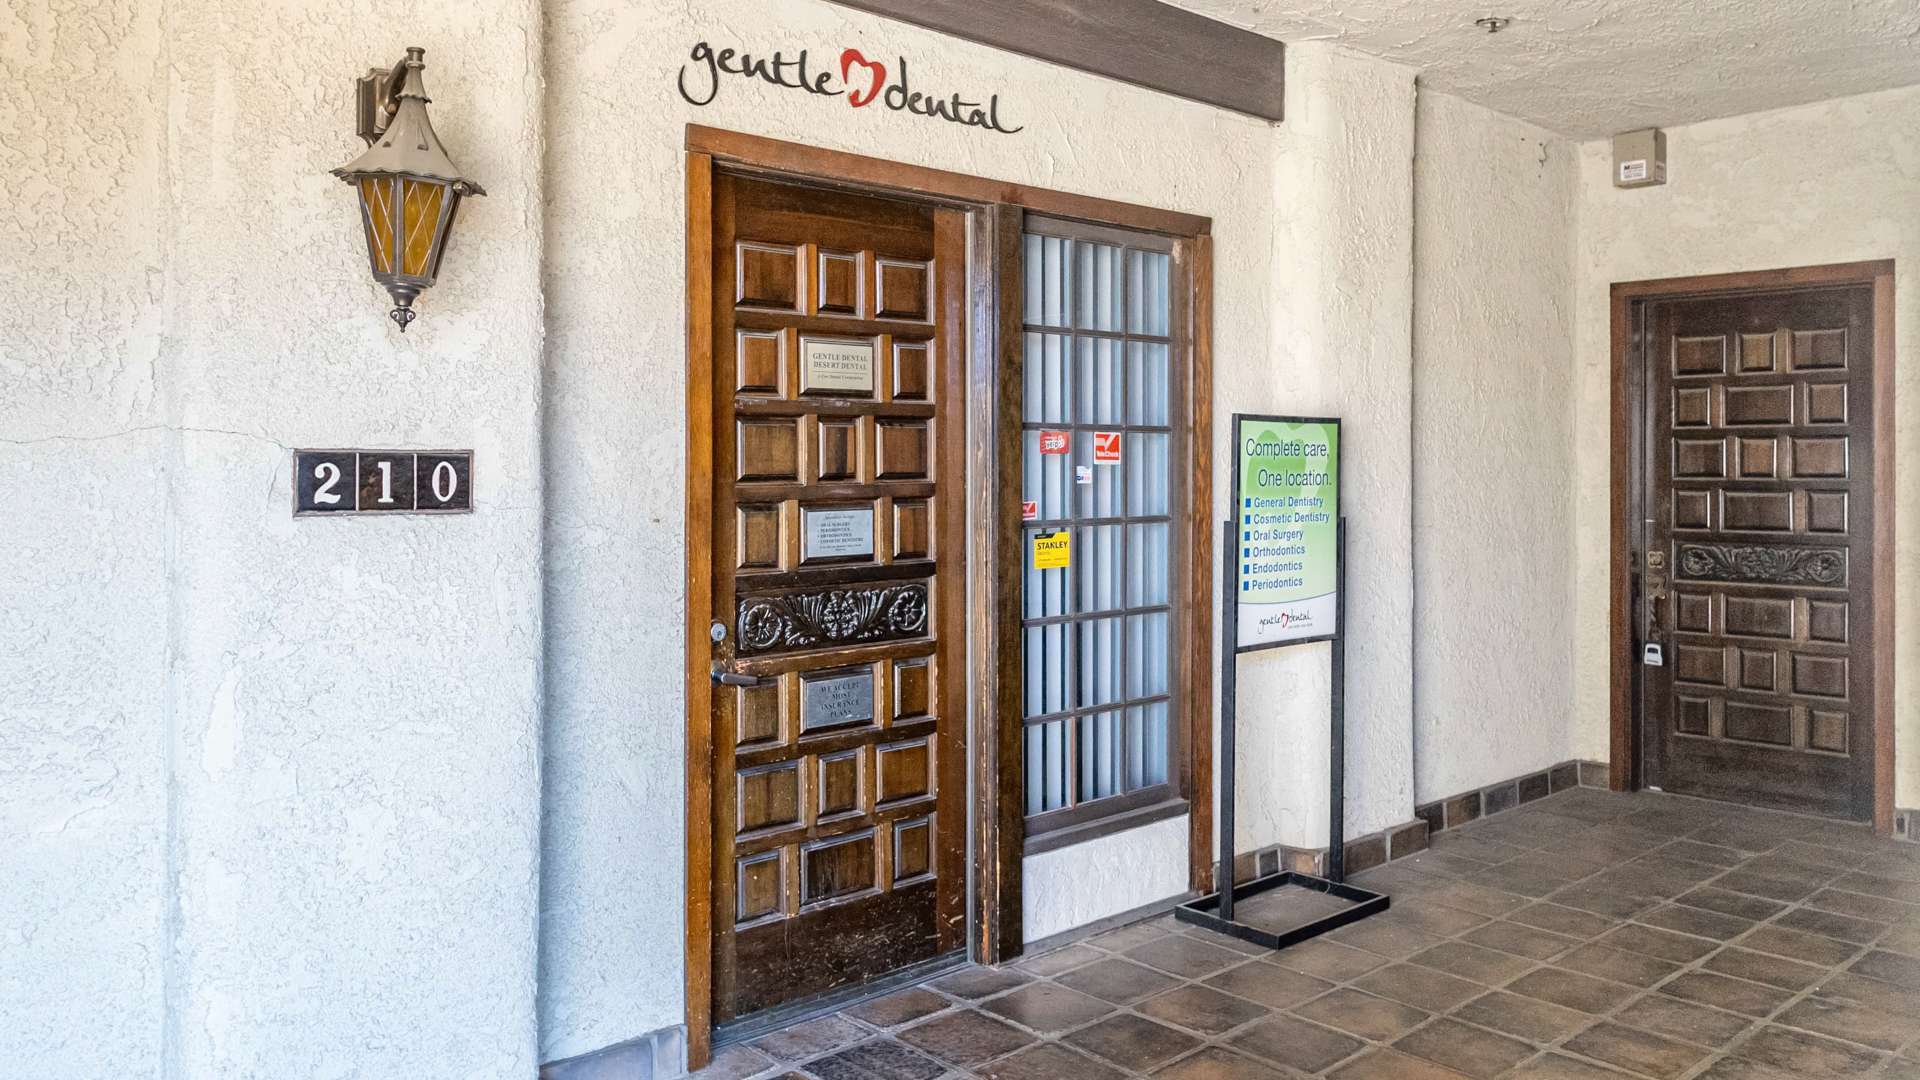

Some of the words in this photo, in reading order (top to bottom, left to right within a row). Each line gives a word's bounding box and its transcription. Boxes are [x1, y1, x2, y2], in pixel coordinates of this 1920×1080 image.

[678, 41, 844, 105] gentle
[884, 56, 1023, 134] dental
[813, 353, 840, 361] GENTLE
[842, 354, 868, 362] DENTAL
[814, 361, 840, 369] DESERT
[841, 362, 868, 370] DENTAL
[1246, 438, 1301, 462] Complete
[313, 461, 458, 505] 210
[1258, 468, 1282, 487] One
[1285, 470, 1332, 487] location.
[1254, 496, 1286, 508] General
[1288, 496, 1324, 509] Dentistry
[1253, 513, 1292, 525] Cosmetic
[1294, 511, 1330, 524] Dentistry
[1253, 529, 1271, 541] Oral
[1272, 529, 1304, 543] Surgery
[1037, 541, 1068, 550] STANLEY
[1252, 544, 1305, 558] Orthodontics
[1252, 561, 1303, 574] Endodontics
[1252, 577, 1303, 590] Periodontics
[1258, 613, 1281, 634] gentle
[1289, 608, 1312, 622] dental
[834, 681, 859, 691] ACCEPT
[832, 692, 851, 700] MOST
[821, 699, 860, 711] INSURANCE
[830, 710, 852, 718] PLANS
